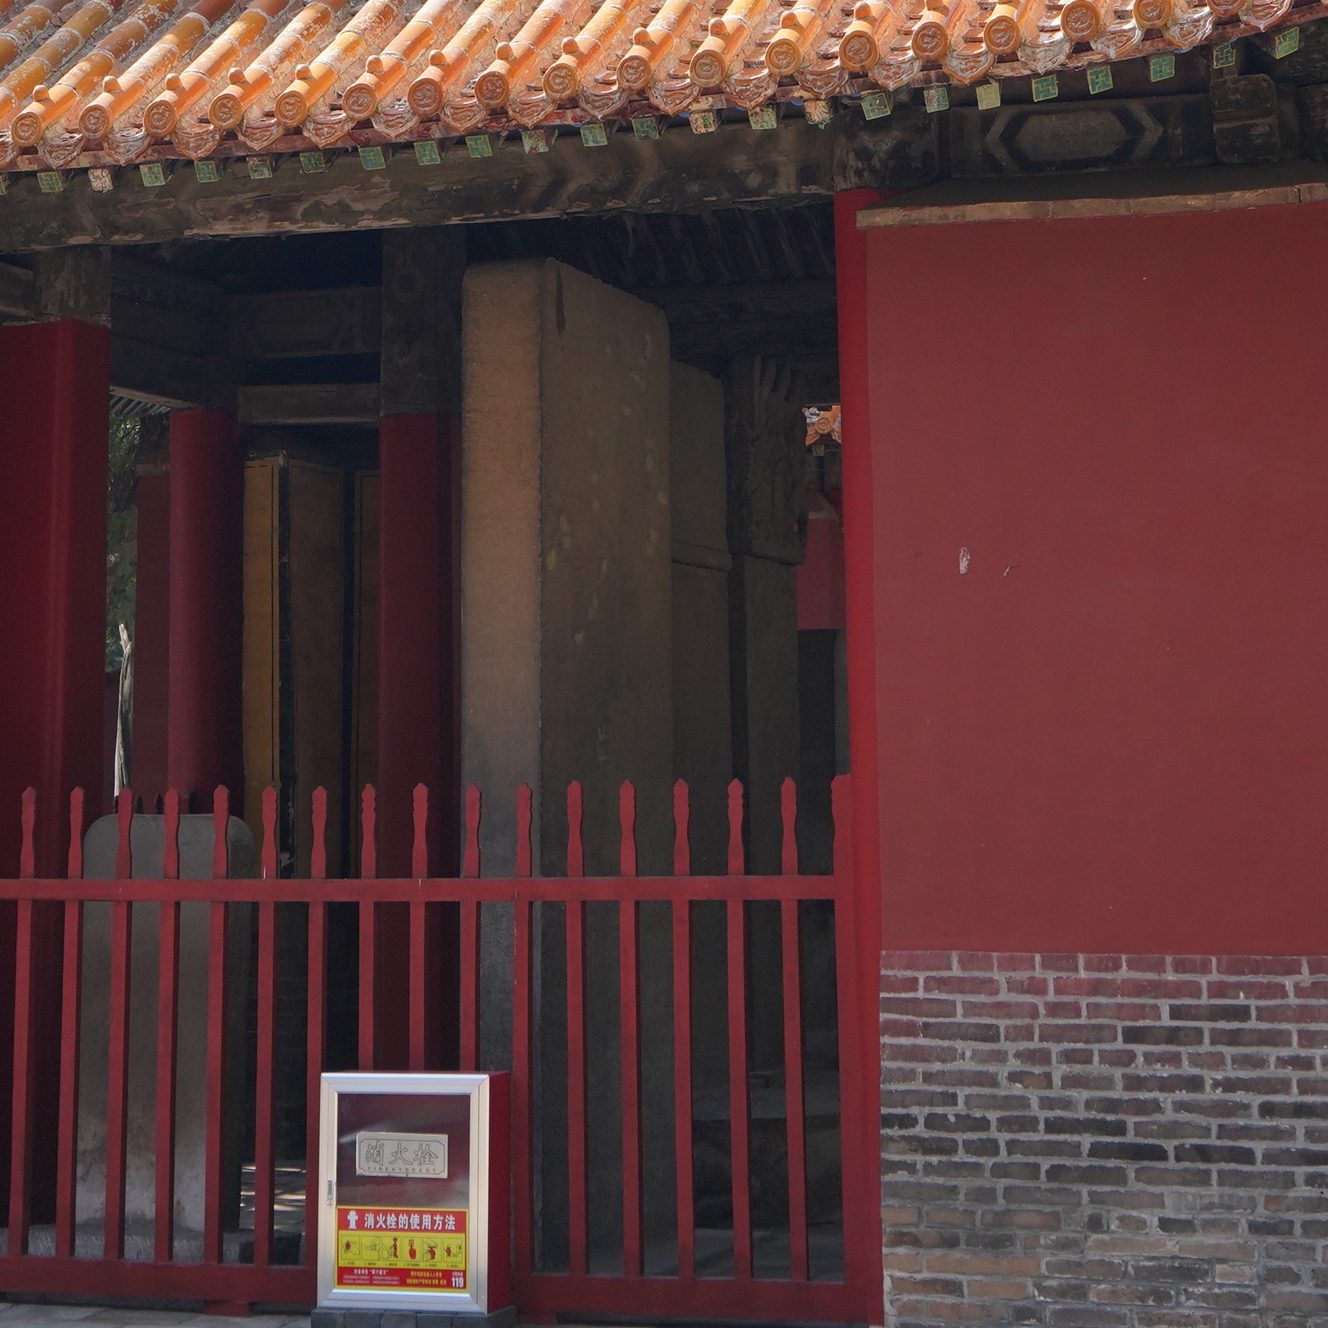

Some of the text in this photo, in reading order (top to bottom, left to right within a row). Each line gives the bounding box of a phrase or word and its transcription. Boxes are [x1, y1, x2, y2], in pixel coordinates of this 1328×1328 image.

[365, 1140, 439, 1166] 消火栓
[364, 1213, 456, 1230] 消火栓的使用方法
[451, 1277, 464, 1288] 119
